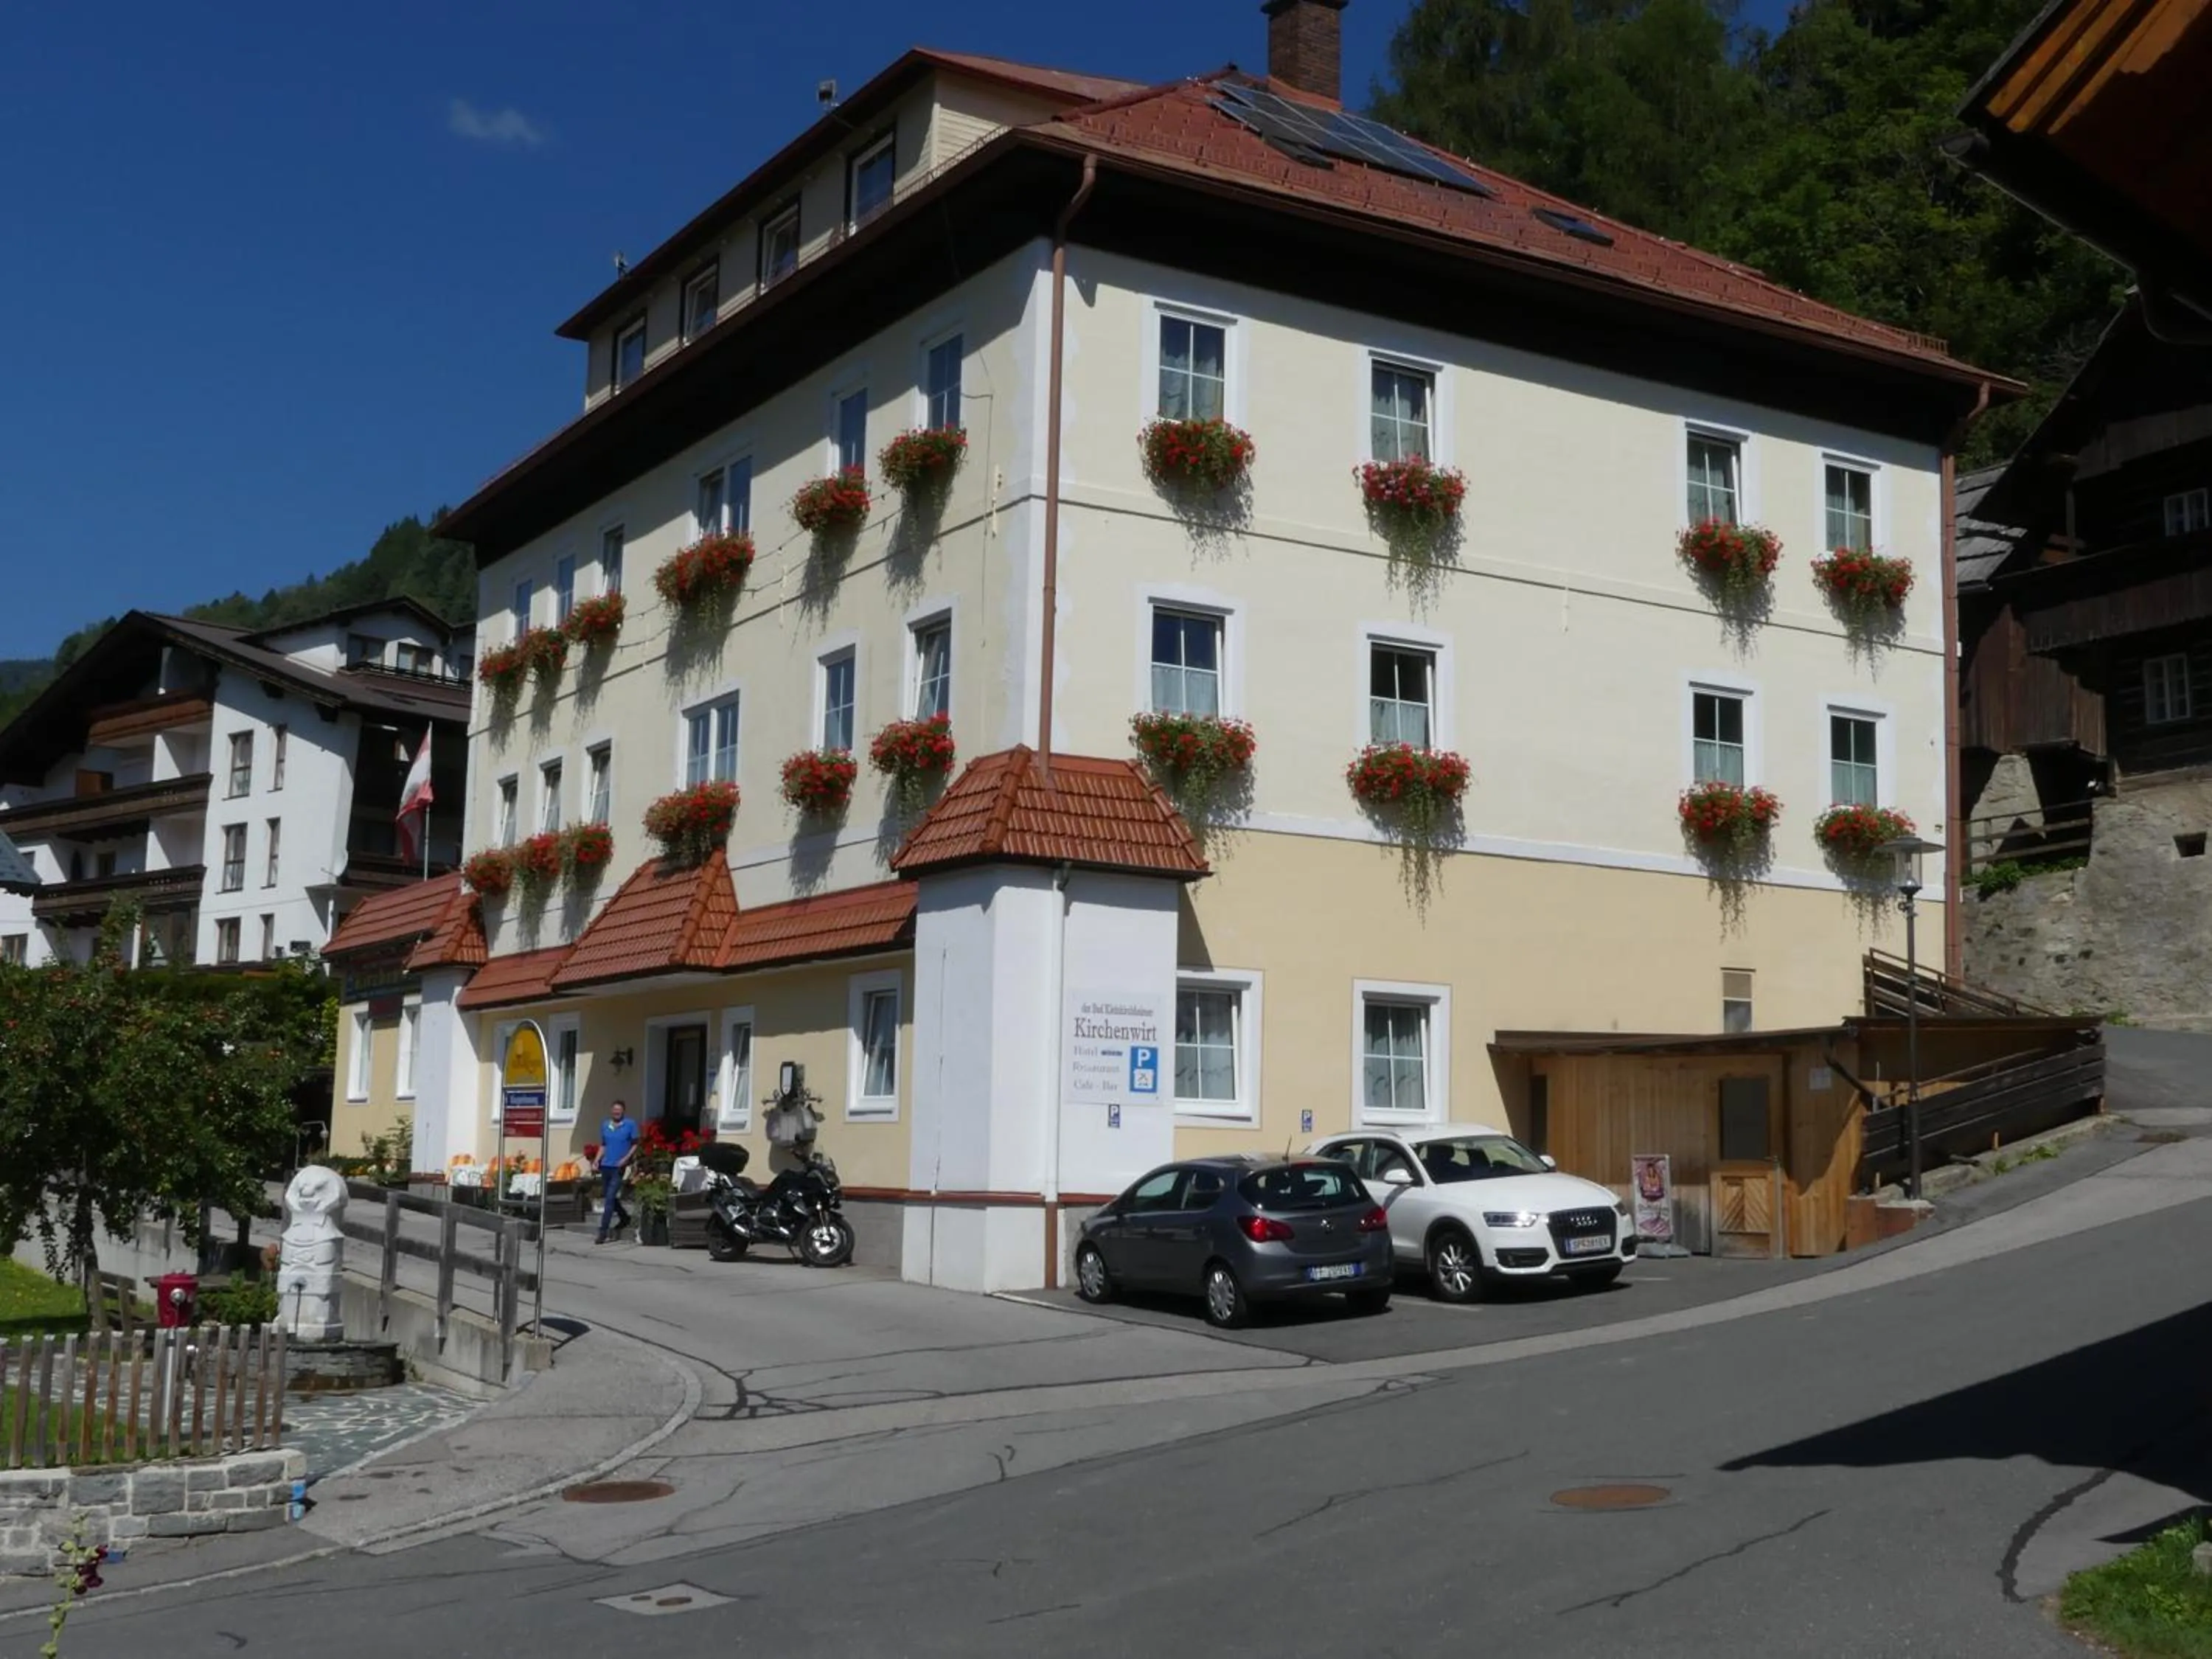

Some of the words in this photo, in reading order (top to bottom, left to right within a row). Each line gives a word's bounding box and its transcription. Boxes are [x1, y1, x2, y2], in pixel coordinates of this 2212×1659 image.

[1074, 1017, 1157, 1041] Kirchenwirt
[1138, 1048, 1150, 1067] P
[1110, 1105, 1119, 1117] P
